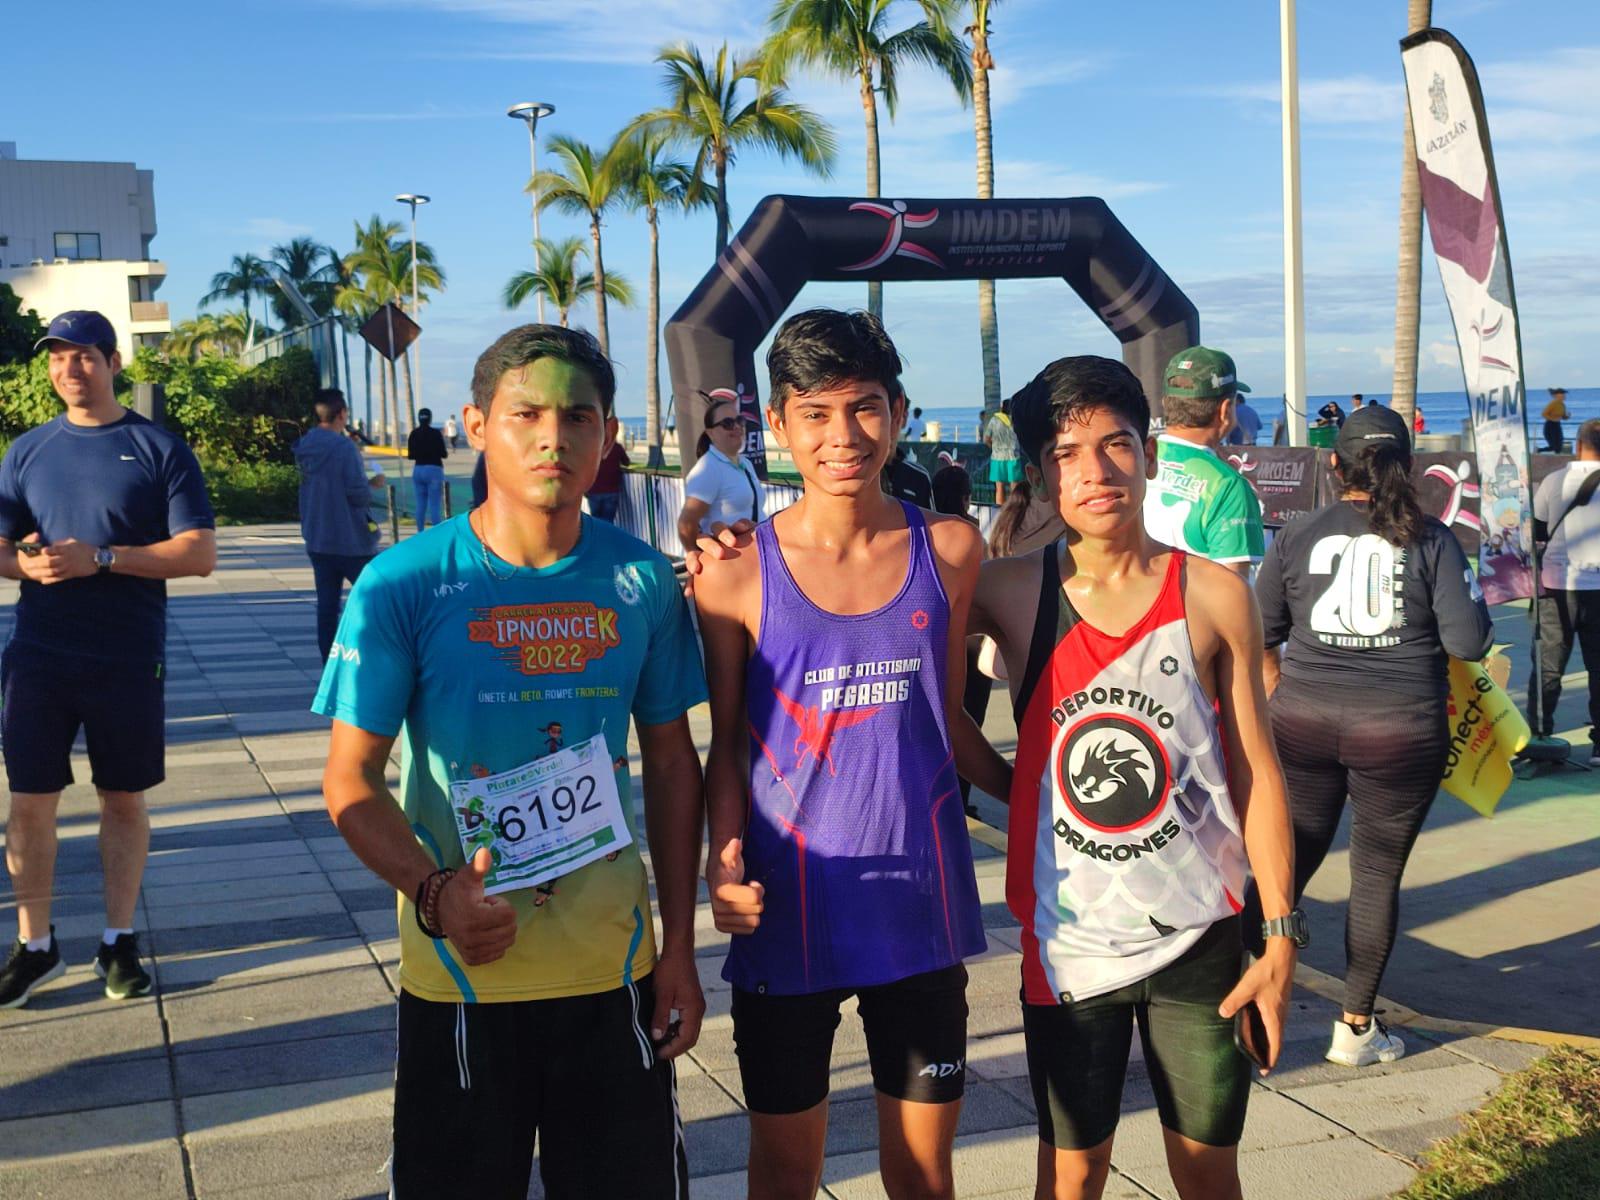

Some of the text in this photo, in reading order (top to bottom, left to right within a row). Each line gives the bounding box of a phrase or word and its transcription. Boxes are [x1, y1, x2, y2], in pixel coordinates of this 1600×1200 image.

[951, 207, 1071, 242] IMDEM
[1257, 462, 1305, 480] IMDEM
[1308, 533, 1394, 636] 20
[524, 643, 582, 670] 2022
[804, 658, 922, 685] CLUB DE ATLETISMO
[478, 689, 507, 703] ÚNETE
[508, 692, 519, 702] AL
[545, 688, 574, 700] ROMPE
[575, 687, 620, 698] FRONTERAS
[821, 680, 910, 711] PEGASOS
[1051, 687, 1175, 729] DEPORTIVO
[497, 775, 602, 842] 6192
[1052, 817, 1181, 862] DRAGONES
